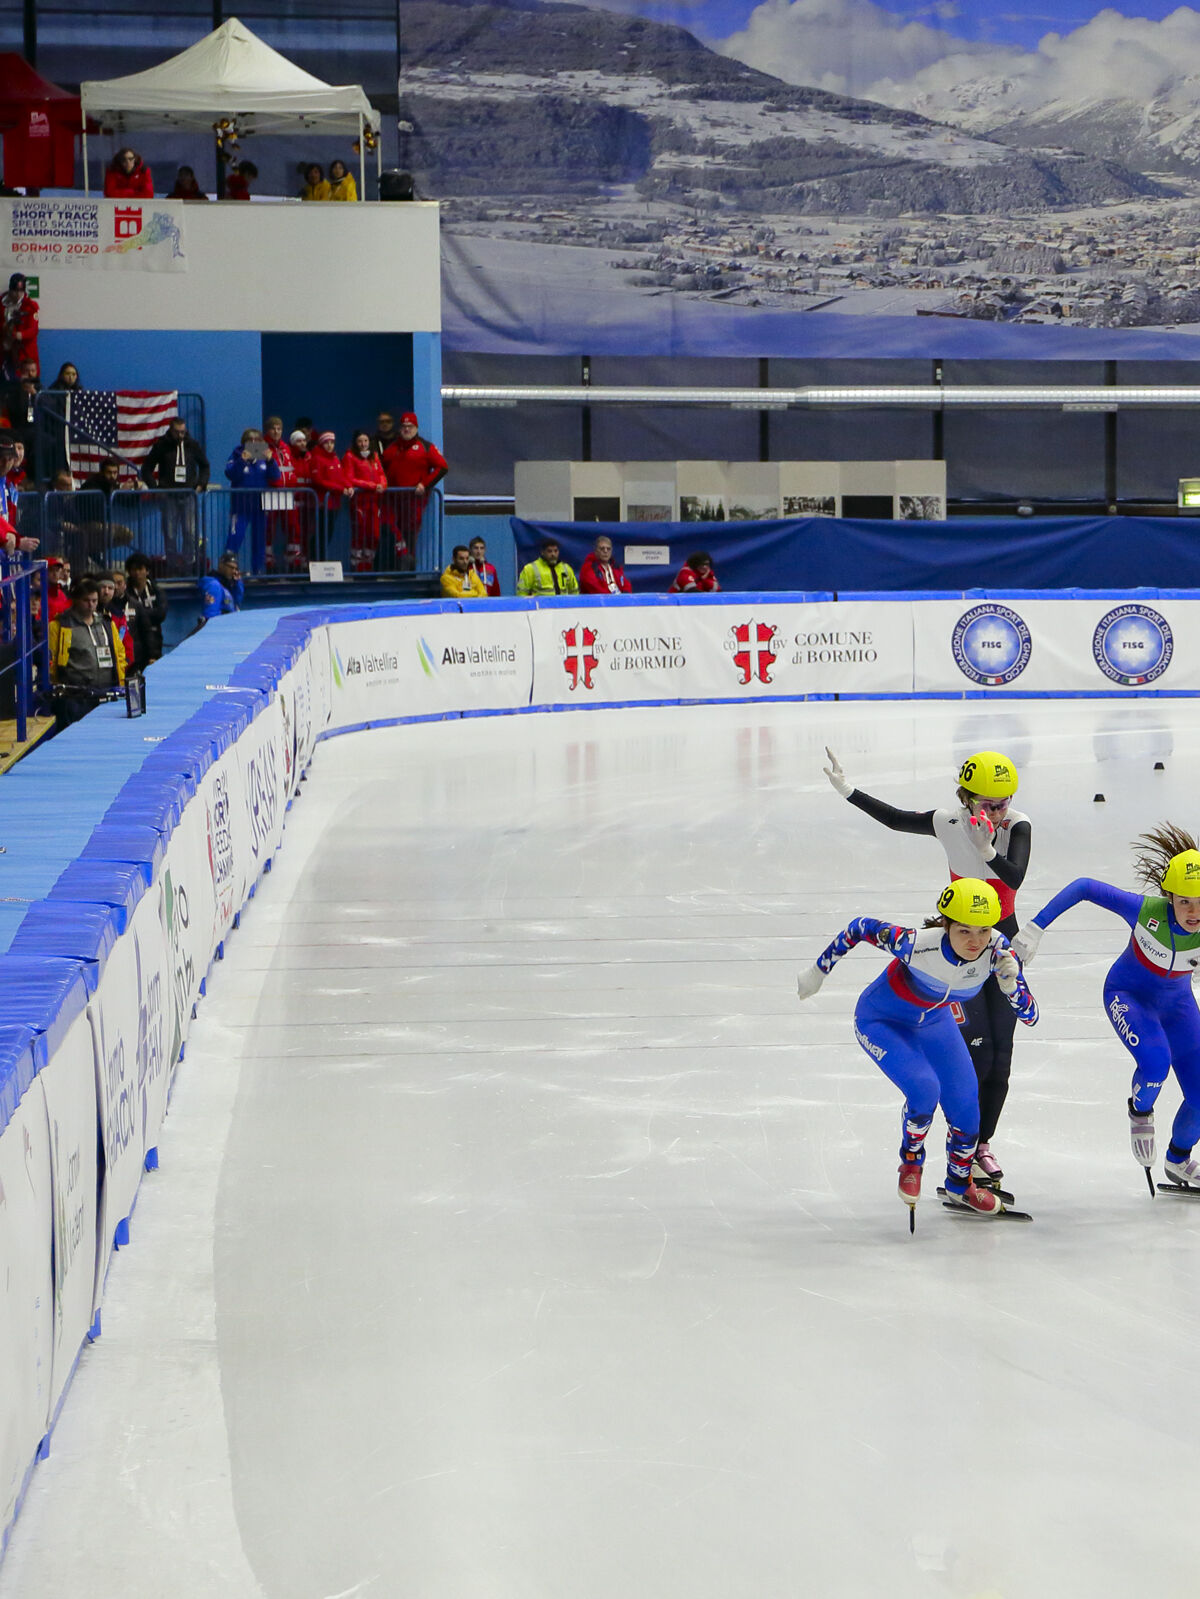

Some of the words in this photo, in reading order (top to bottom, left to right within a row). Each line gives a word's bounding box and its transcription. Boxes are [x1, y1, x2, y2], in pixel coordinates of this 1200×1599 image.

[12, 210, 52, 220] SHORT
[57, 211, 98, 220] TRACK
[23, 202, 59, 211] WORLD
[63, 203, 99, 212] JUNIOR
[12, 220, 48, 229] SPEED
[52, 220, 99, 230] SKATING
[12, 229, 99, 238] CHAMPIONSHIPS
[12, 243, 63, 254] BORMIO
[67, 244, 99, 255] 2020
[960, 605, 995, 627] ITALIANA
[996, 606, 1020, 624] SPORT
[1101, 606, 1137, 627] ITALIANA
[1139, 606, 1164, 625] SPORT
[794, 632, 873, 646] COMUNE
[1018, 623, 1029, 641] DEL
[1161, 624, 1172, 641] DEL
[613, 637, 683, 652] COMUNE
[981, 641, 1002, 649] FISG
[1122, 641, 1145, 649] FISG
[441, 648, 466, 666] Alta
[466, 646, 515, 664] Valtellina
[792, 651, 802, 664] di
[807, 649, 878, 664] BORMIO
[953, 627, 980, 681] FEDERAZIONE
[1005, 642, 1031, 681] GHIACCIO
[1094, 627, 1121, 681] FEDERAZIONE
[1147, 642, 1173, 681] GHIACCIO
[610, 657, 620, 670] di
[624, 655, 686, 670] BORMIO
